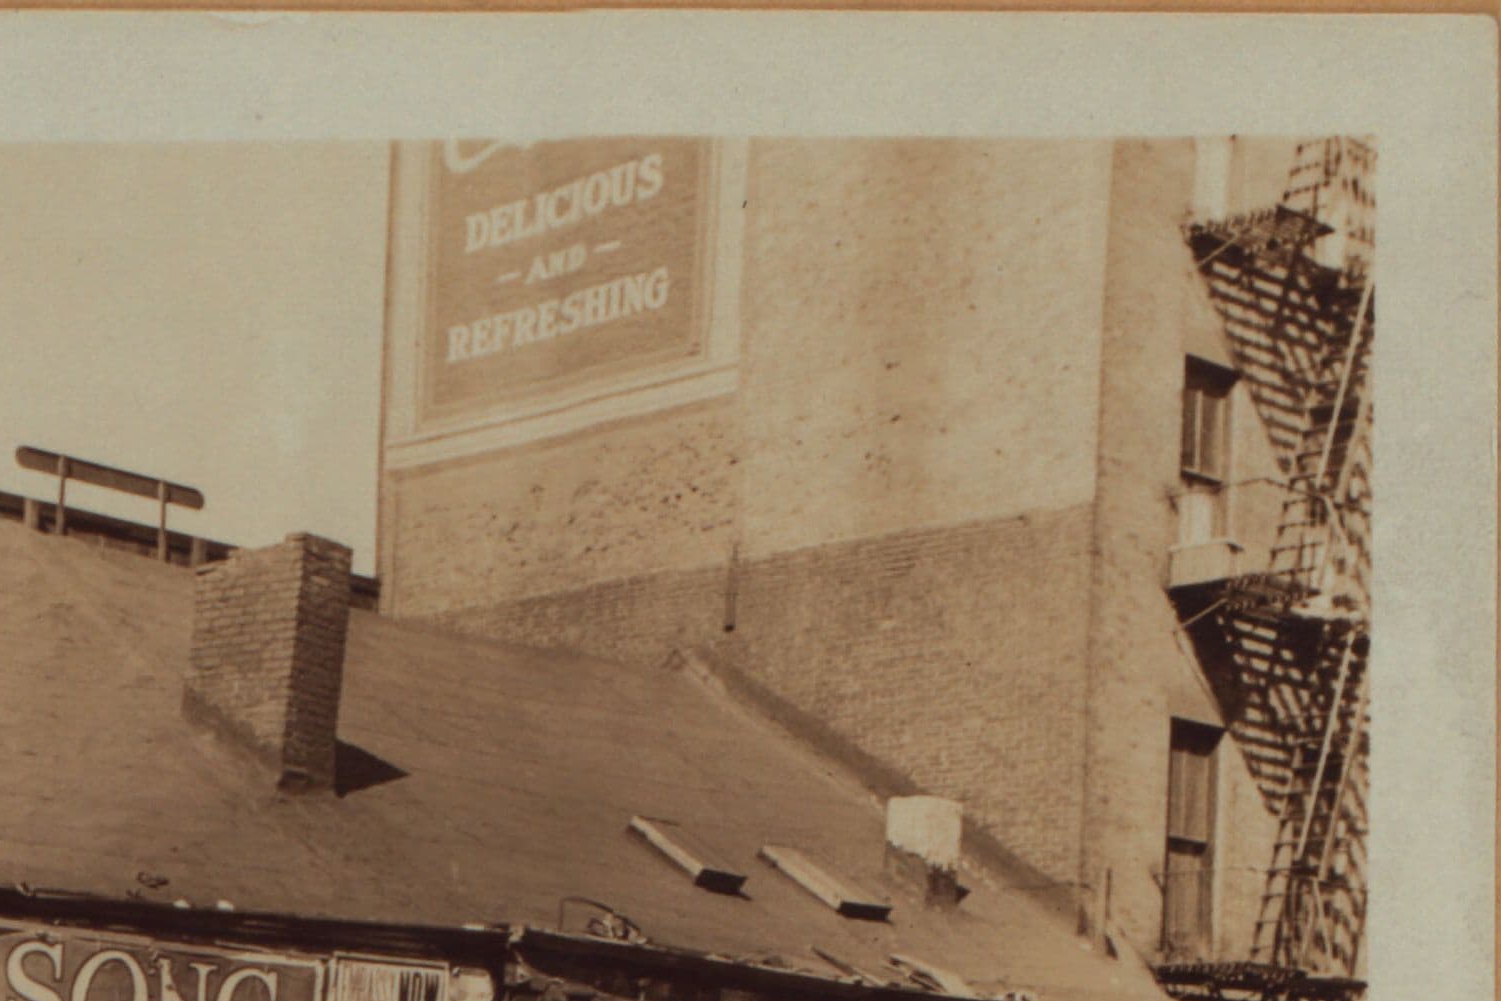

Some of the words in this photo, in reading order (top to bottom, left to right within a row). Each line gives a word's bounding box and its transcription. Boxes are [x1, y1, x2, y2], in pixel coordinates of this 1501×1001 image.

[464, 154, 665, 254] DELICIOUS
[526, 242, 588, 286] AND
[446, 265, 670, 365] REFRESHING
